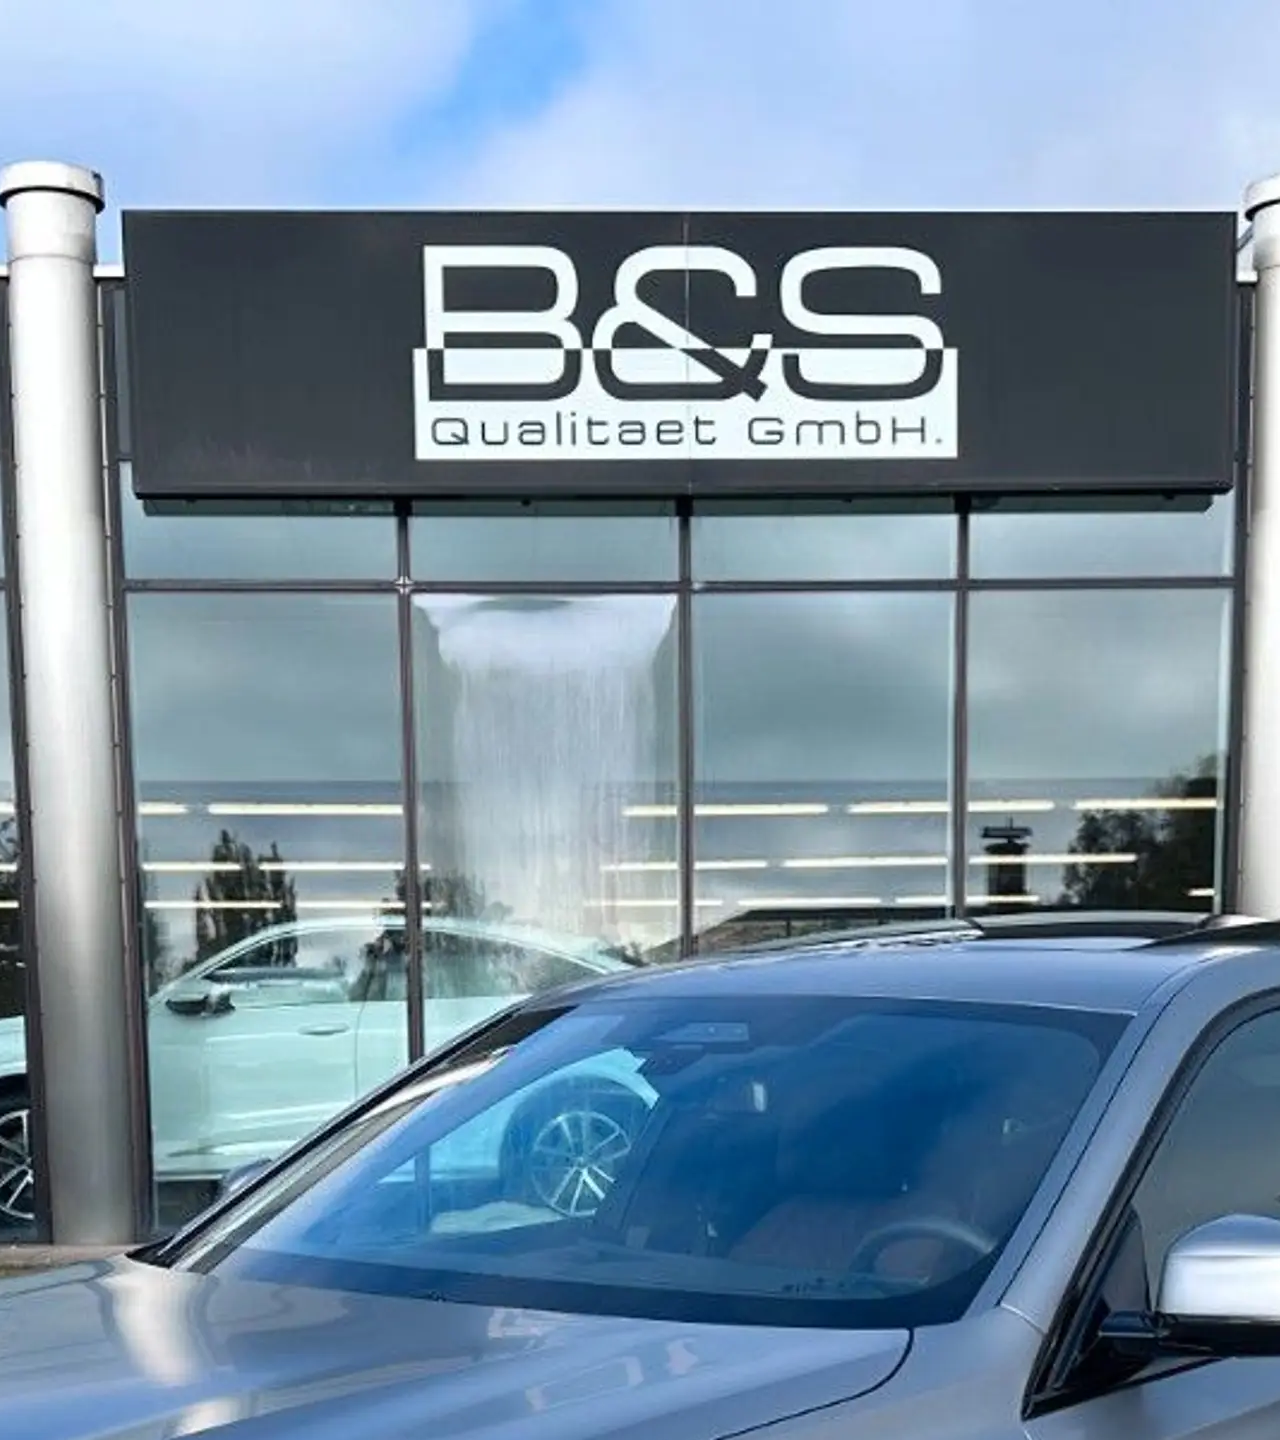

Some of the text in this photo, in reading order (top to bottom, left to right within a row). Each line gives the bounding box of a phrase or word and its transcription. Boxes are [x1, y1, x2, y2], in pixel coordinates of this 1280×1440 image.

[422, 244, 945, 402] B&S
[430, 410, 944, 447] Qualitaet GmbH.
